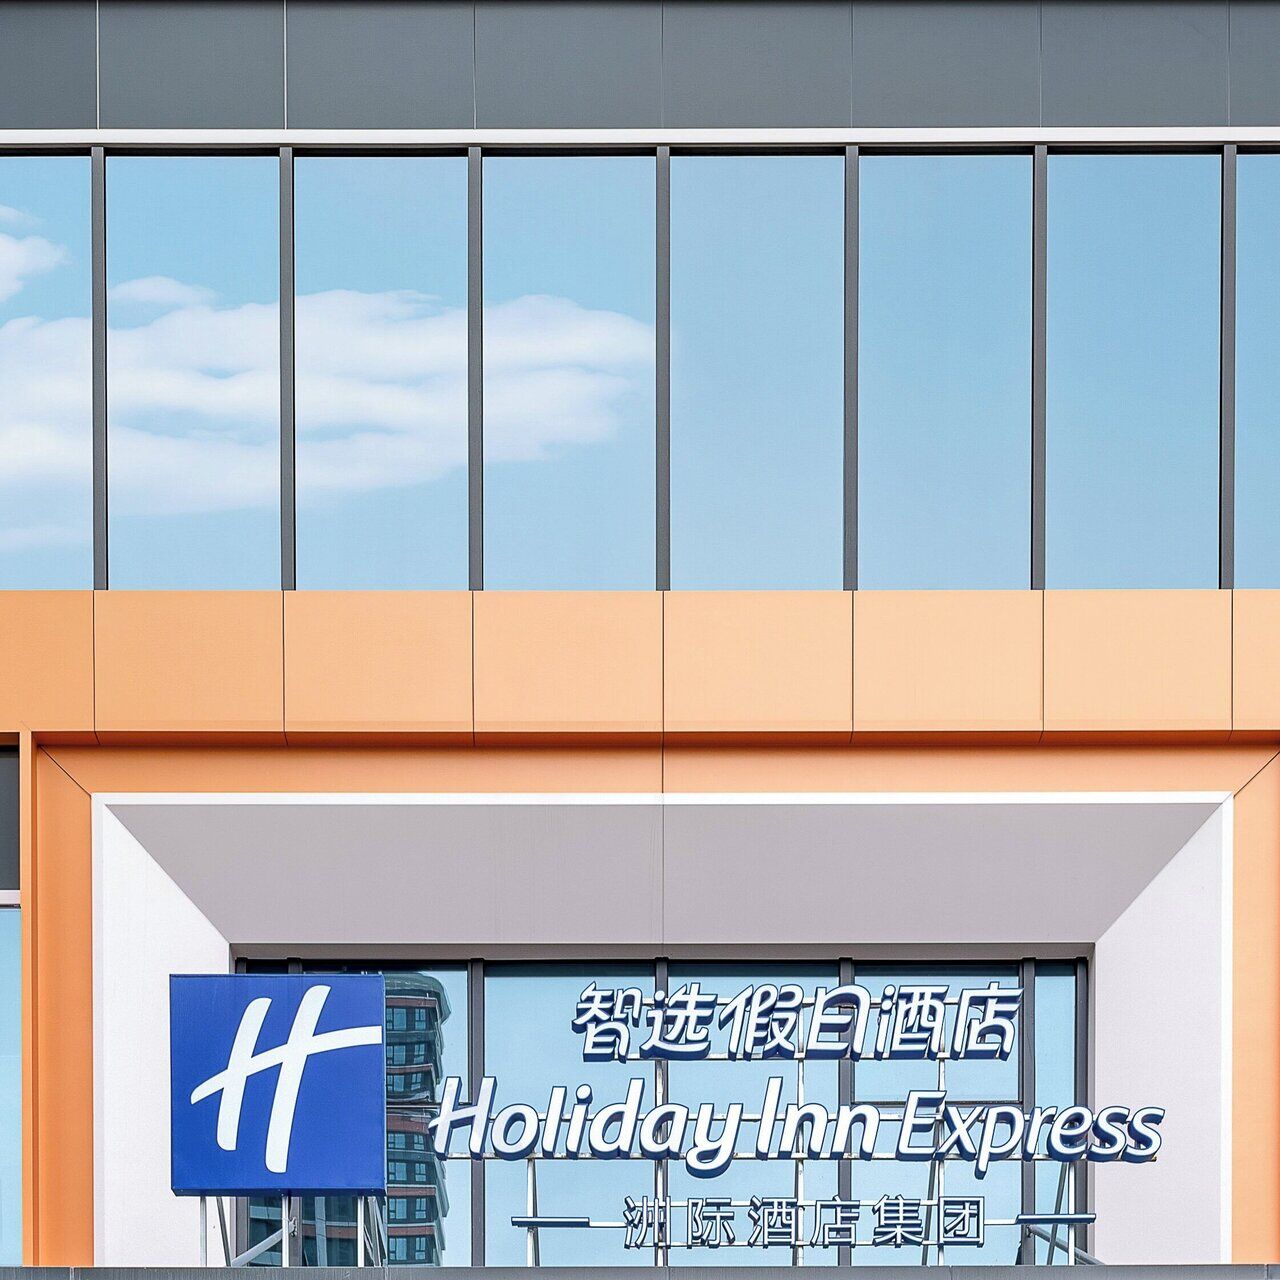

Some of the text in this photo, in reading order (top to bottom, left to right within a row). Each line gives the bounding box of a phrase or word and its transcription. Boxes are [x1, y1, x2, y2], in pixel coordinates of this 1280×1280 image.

[572, 981, 1024, 1064] 智选假日酒店
[428, 1076, 1166, 1180] Holiday Inn Express
[624, 1195, 985, 1249] 洲际酒店集团
